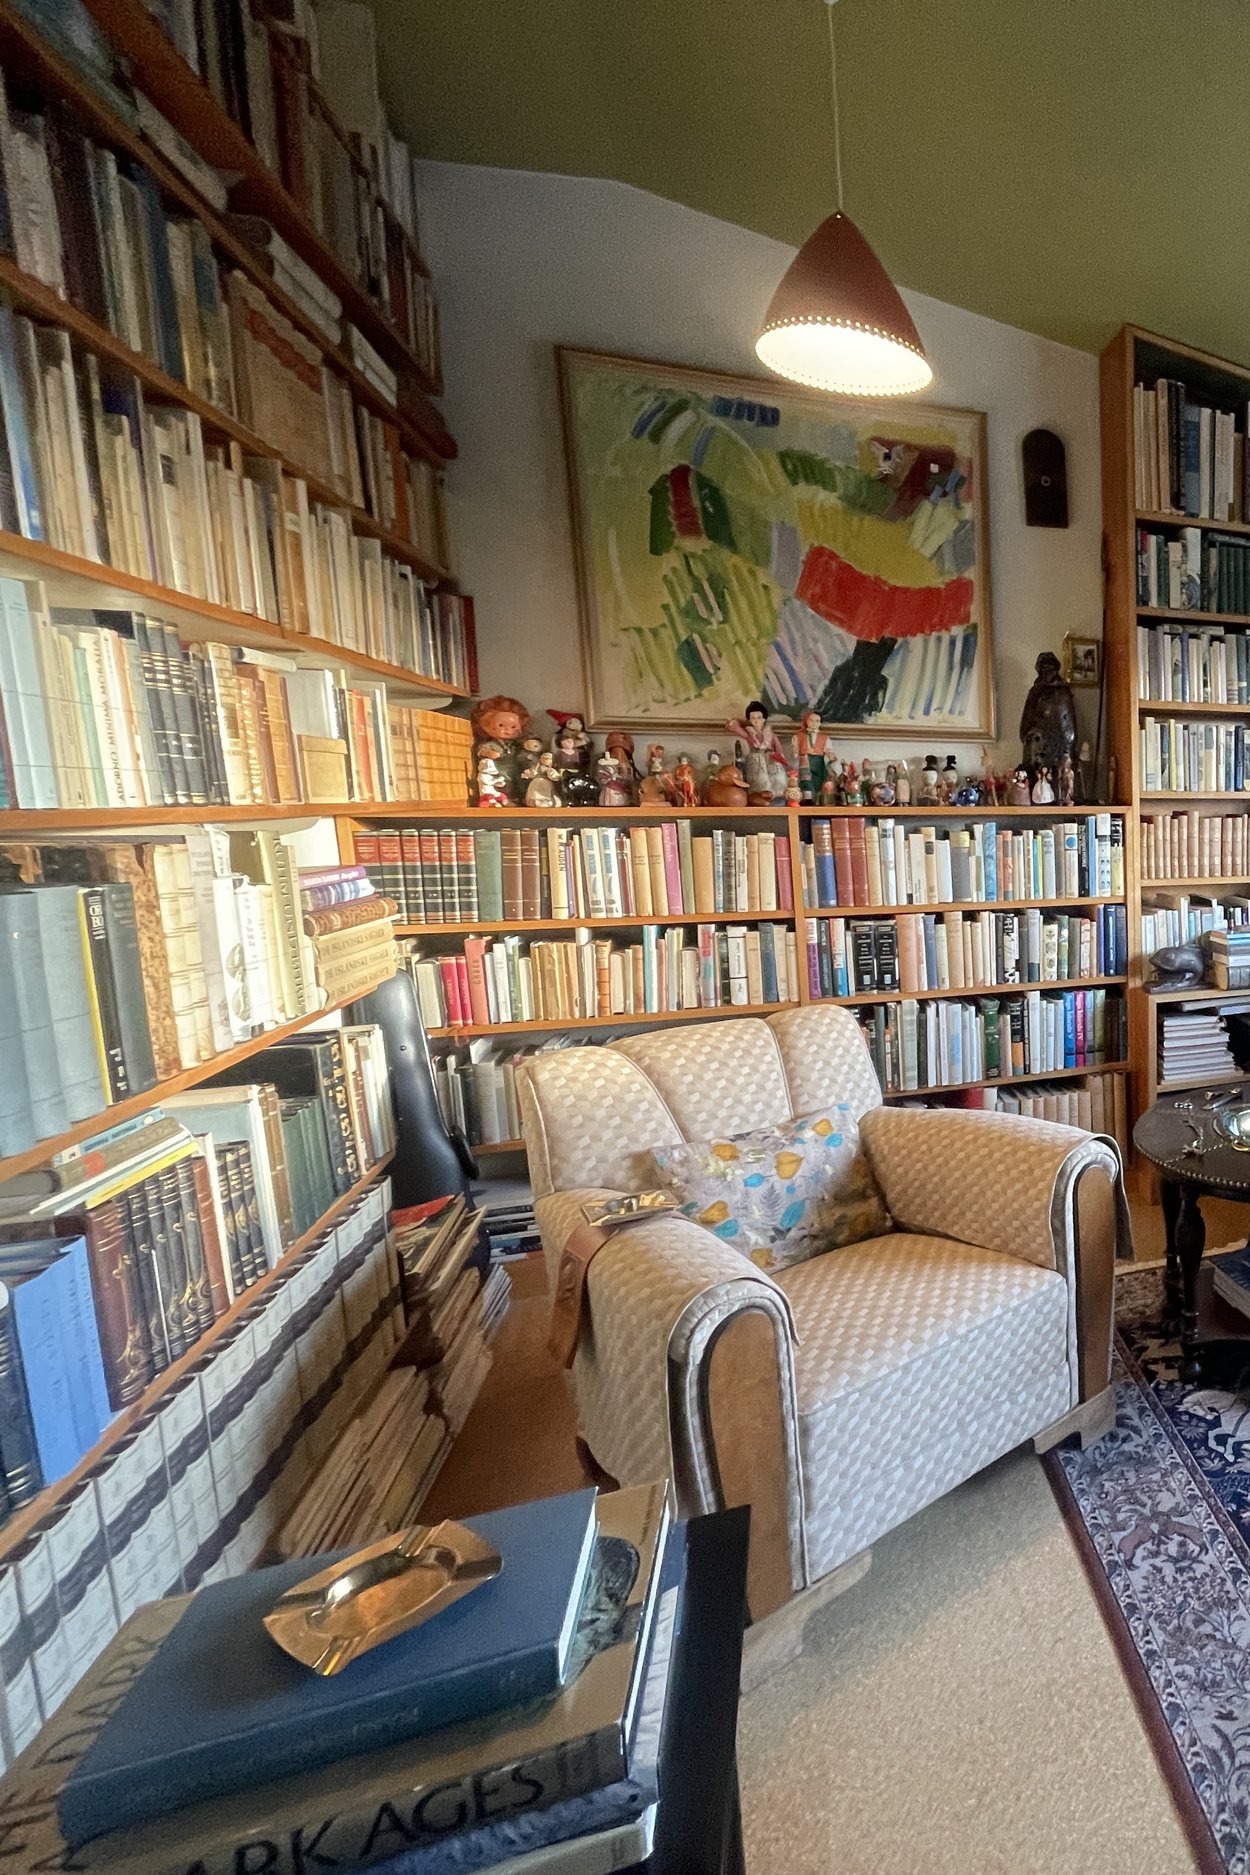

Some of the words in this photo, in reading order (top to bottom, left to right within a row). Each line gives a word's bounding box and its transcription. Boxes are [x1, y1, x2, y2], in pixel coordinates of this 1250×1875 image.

[103, 701, 117, 746] MINIMA
[110, 751, 126, 801] ADORNO
[358, 1764, 545, 1859] AGES
